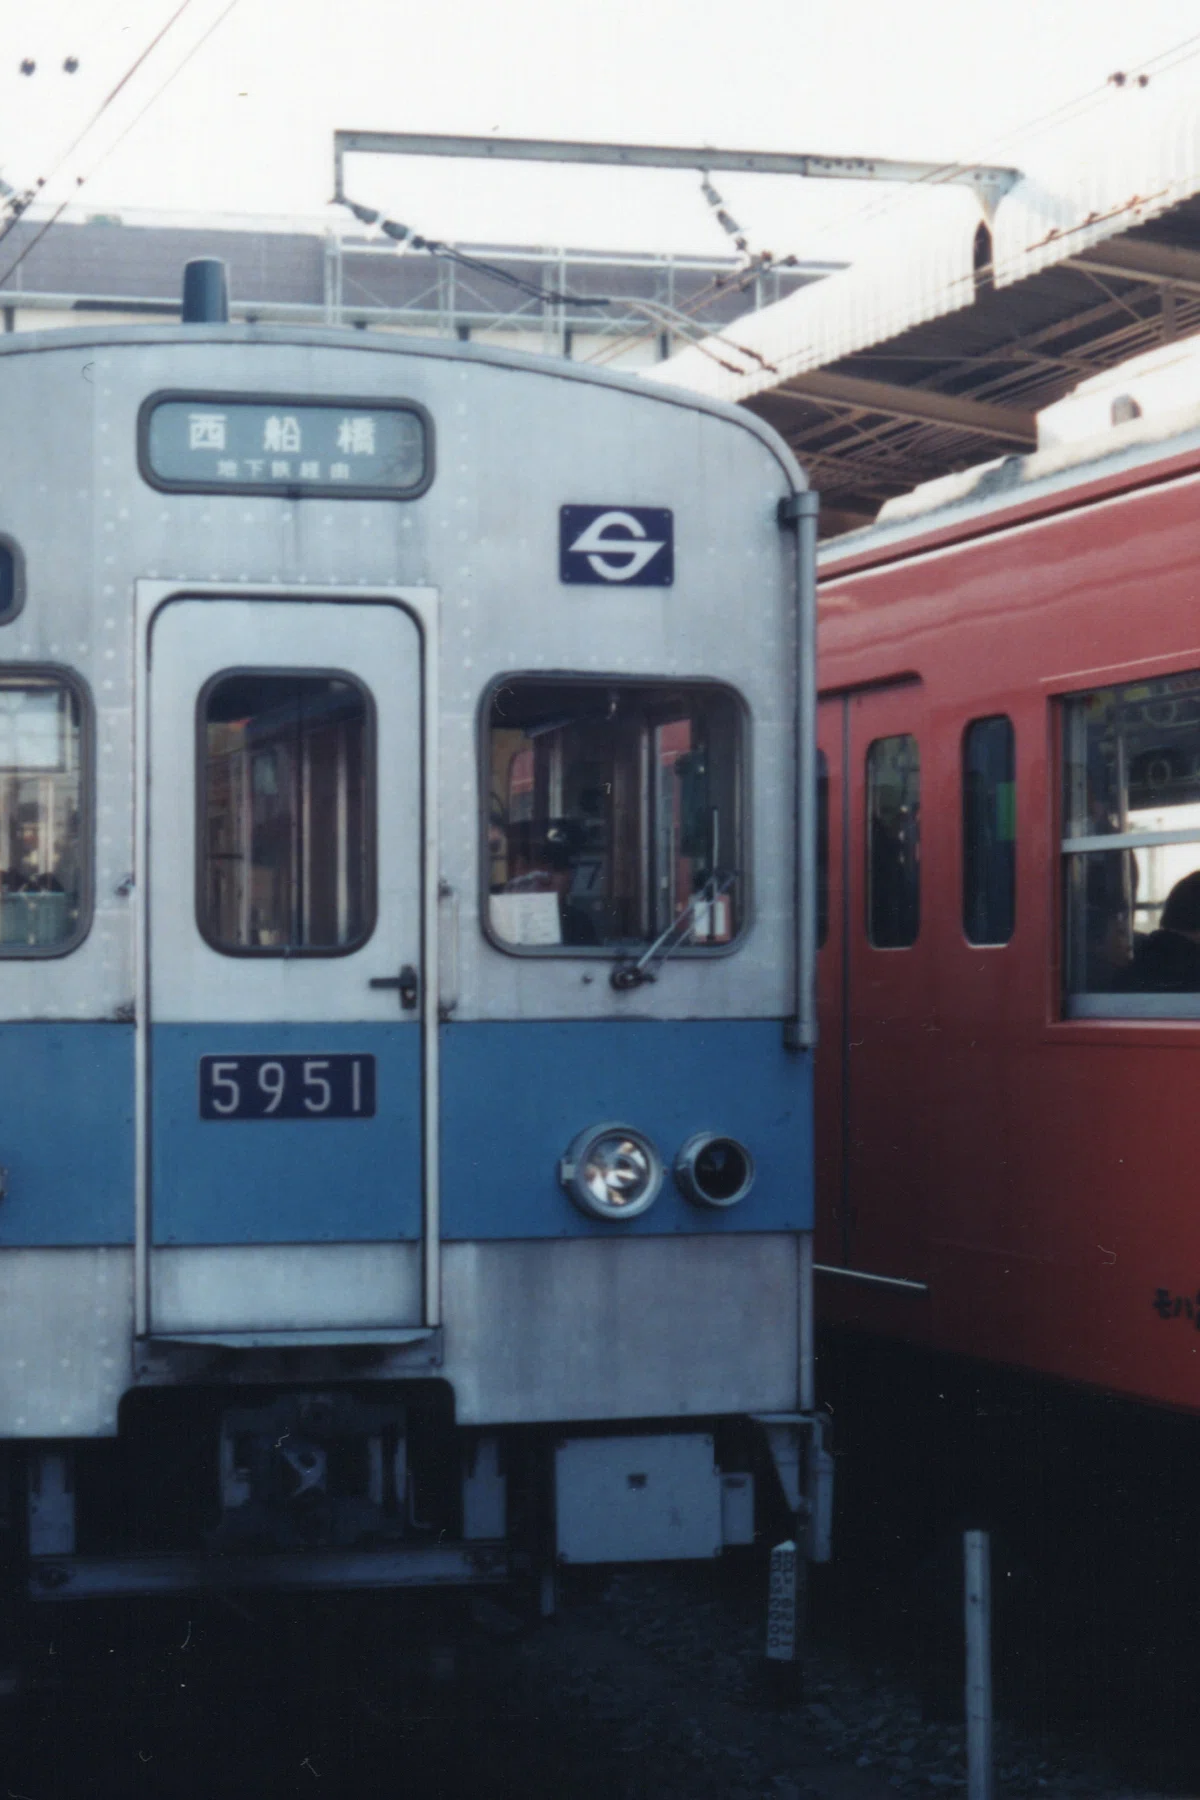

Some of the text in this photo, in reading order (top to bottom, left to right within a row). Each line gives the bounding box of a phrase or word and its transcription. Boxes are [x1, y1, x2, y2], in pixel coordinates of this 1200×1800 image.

[188, 413, 375, 455] 西船橋
[211, 1061, 361, 1114] 5951
[1151, 1287, 1200, 1333] モハ
